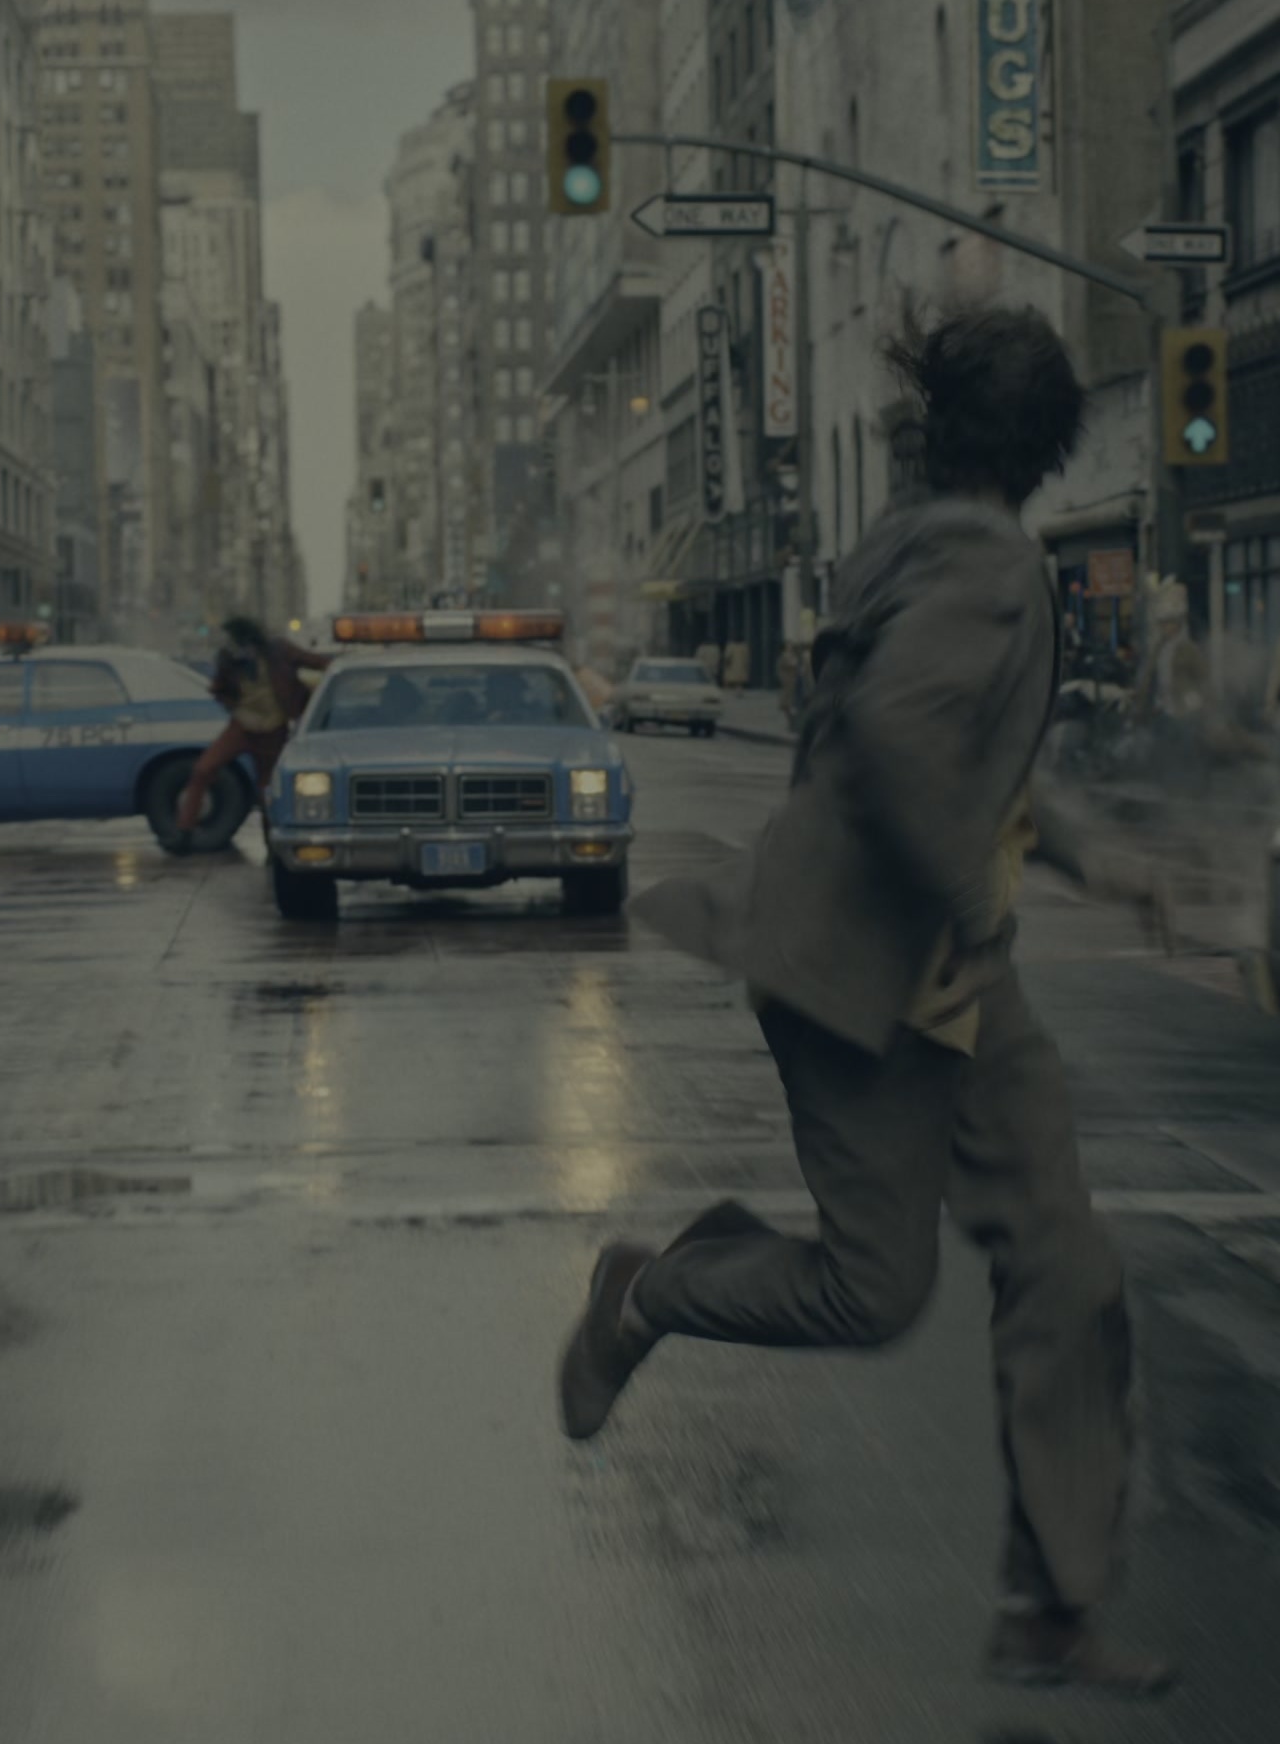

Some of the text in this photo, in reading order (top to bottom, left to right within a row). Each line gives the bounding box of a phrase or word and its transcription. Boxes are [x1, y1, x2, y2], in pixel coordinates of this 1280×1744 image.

[987, 0, 1034, 160] UGS
[664, 206, 762, 226] ONE WAY
